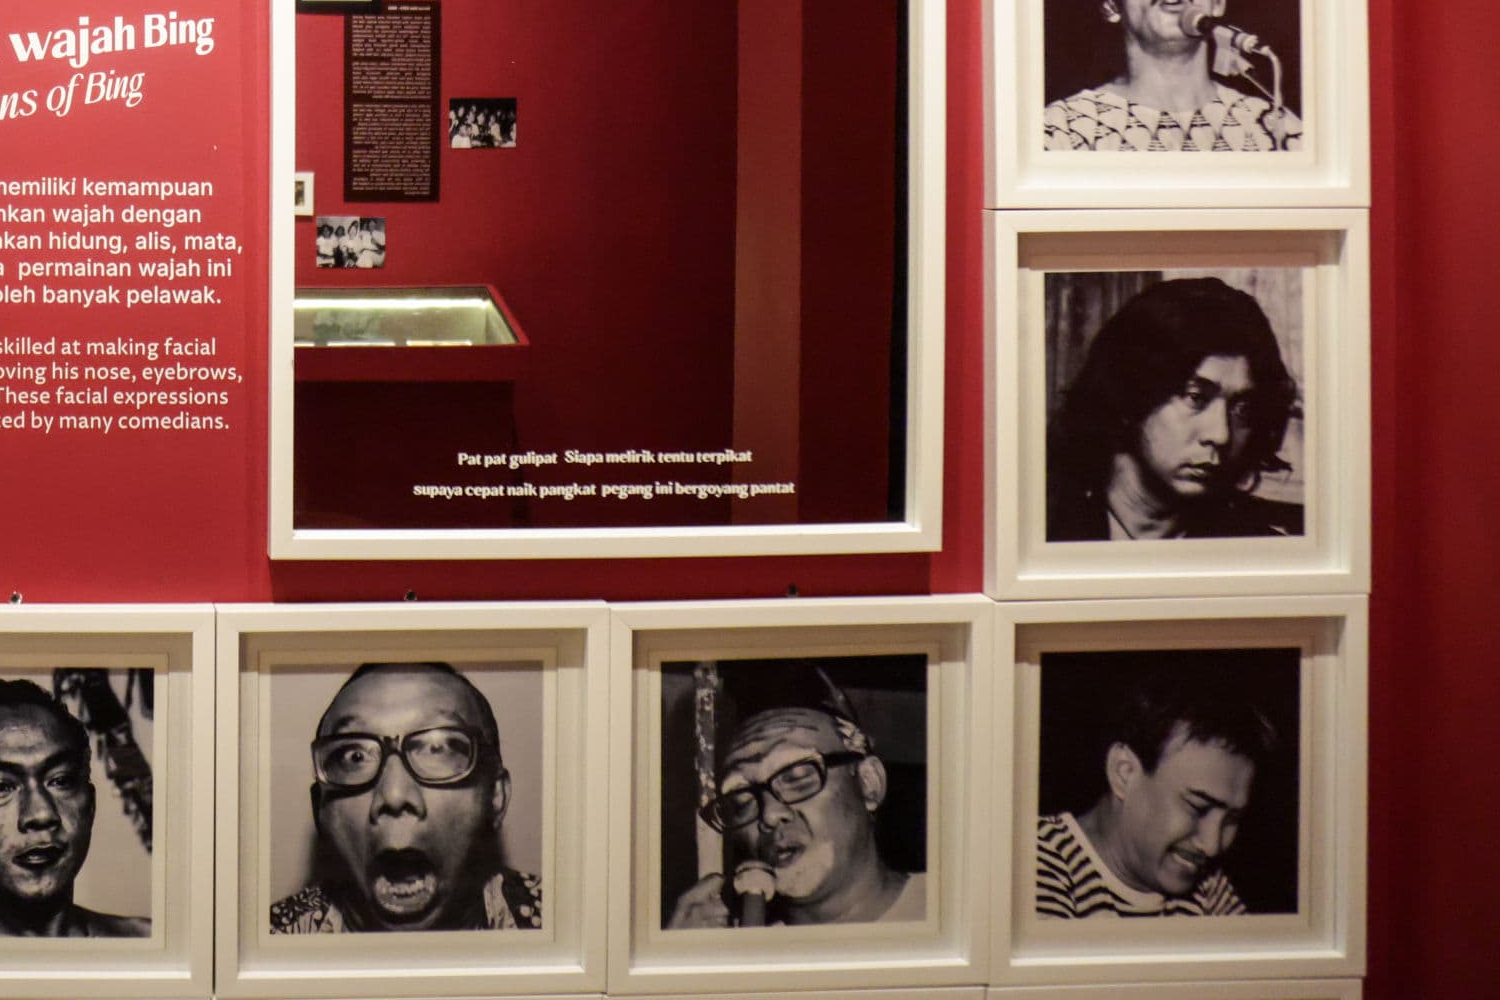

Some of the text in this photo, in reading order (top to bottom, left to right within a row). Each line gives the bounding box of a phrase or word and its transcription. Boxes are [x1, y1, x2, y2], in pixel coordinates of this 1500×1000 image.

[8, 15, 135, 69] wajah
[143, 10, 215, 56] Bing
[46, 73, 84, 117] of
[83, 70, 145, 108] Bing
[82, 177, 213, 201] kemampuan
[52, 203, 115, 228] wajah
[121, 204, 202, 228] dengan
[48, 231, 128, 255] hidung,
[135, 231, 177, 254] alis,
[184, 232, 243, 255] mata,
[18, 258, 132, 281] permainan
[138, 257, 201, 281] wajah
[207, 257, 232, 277] ini
[42, 284, 120, 308] banyak
[126, 285, 222, 309] pelawak.
[60, 339, 81, 356] at
[86, 337, 160, 361] making
[163, 336, 216, 356] facial
[51, 361, 79, 380] his
[84, 366, 137, 383] nose,
[141, 361, 243, 385] eyebrows,
[55, 385, 108, 405] facial
[113, 386, 229, 410] expressions
[30, 410, 54, 434] by
[59, 415, 114, 434] many
[117, 410, 230, 430] comedians.
[457, 448, 753, 470] Pat pat gulipat Siapa melirik tentu terpikat
[412, 480, 796, 501] supaya cepat naik pangkat pegang ini bergoyang pantat
